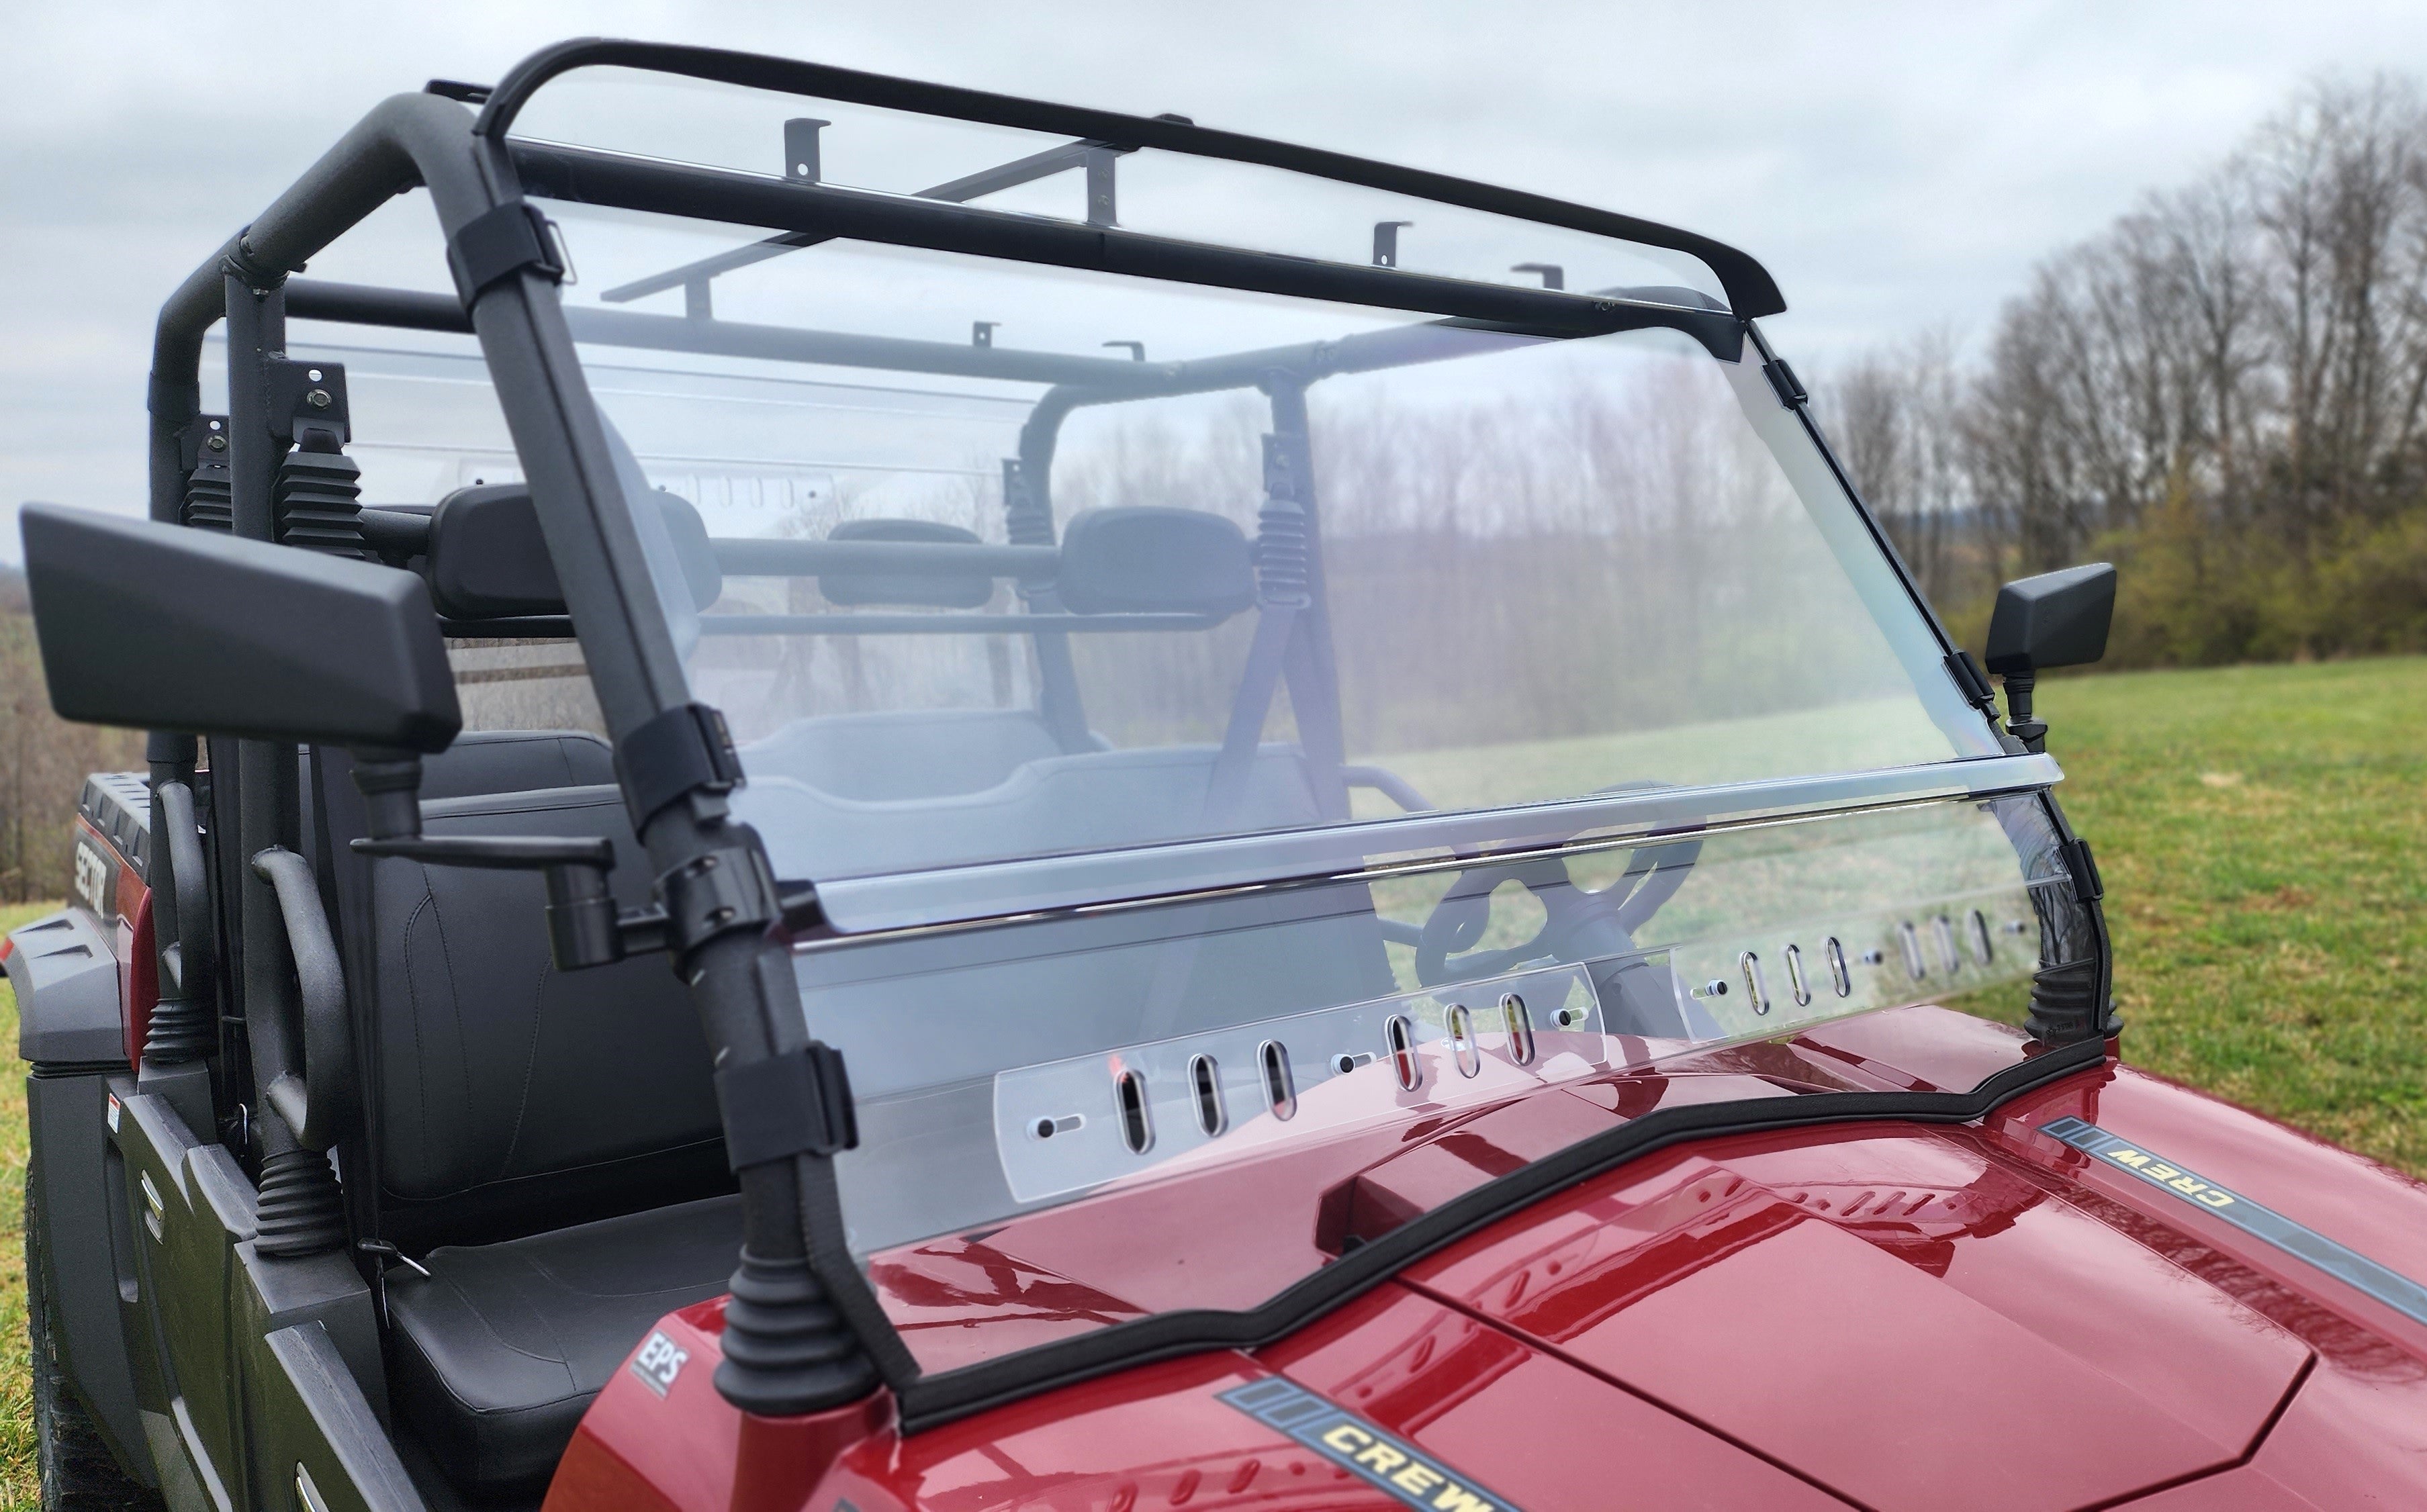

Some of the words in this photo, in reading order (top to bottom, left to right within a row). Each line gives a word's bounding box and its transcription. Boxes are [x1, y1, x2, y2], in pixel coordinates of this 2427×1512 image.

[75, 841, 107, 919] SECTOR
[2107, 1149, 2235, 1207] CREW
[638, 1331, 688, 1384] EPS
[1322, 1424, 1495, 1512] CREW
